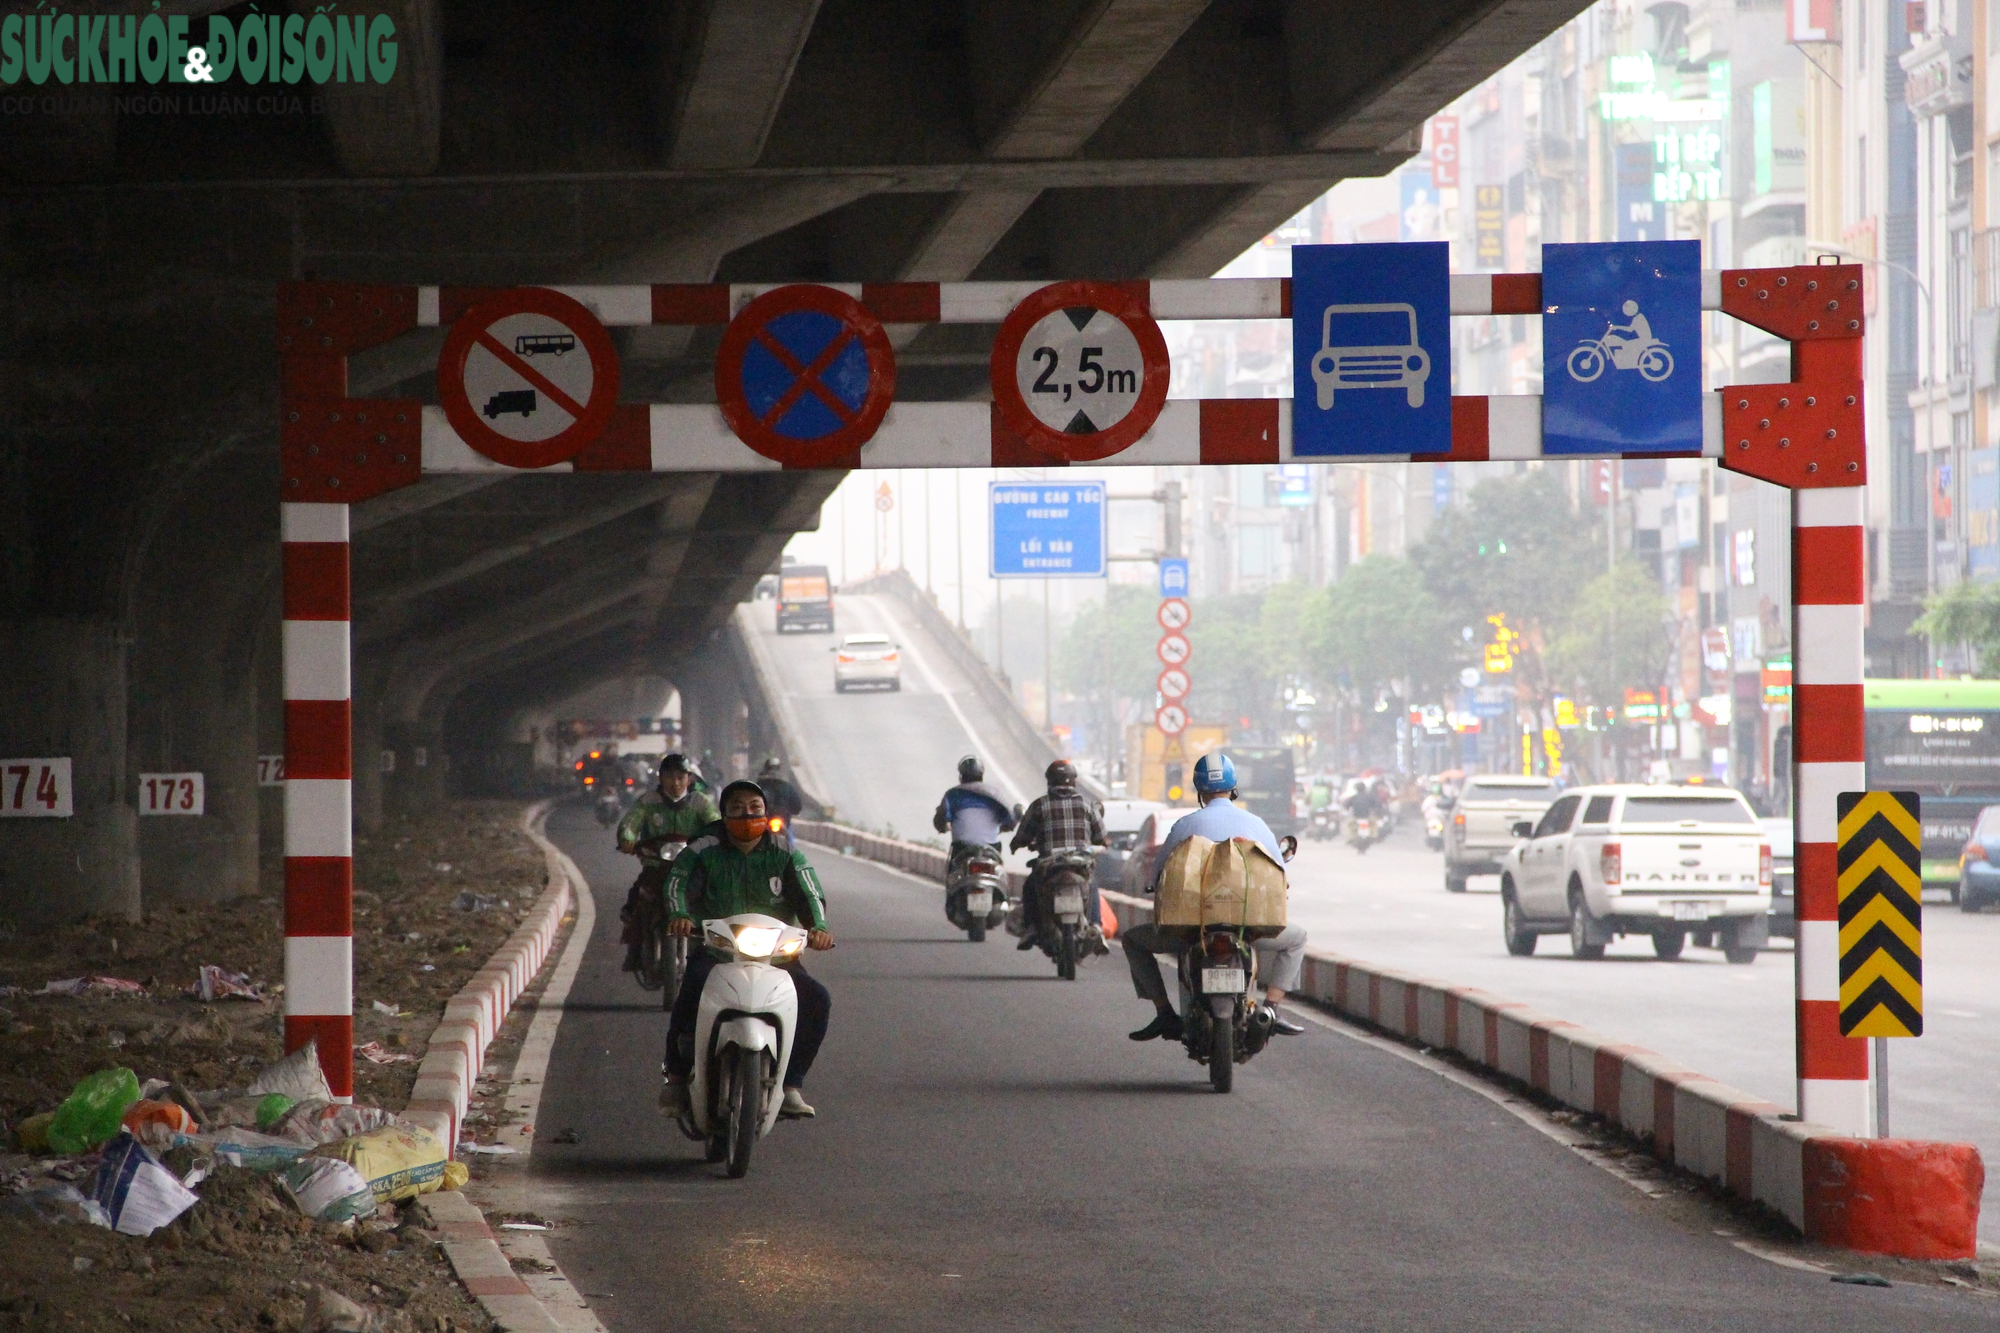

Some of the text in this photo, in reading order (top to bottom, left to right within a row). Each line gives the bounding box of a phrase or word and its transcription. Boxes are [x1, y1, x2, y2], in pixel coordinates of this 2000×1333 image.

[1435, 122, 1456, 183] TCL
[1032, 346, 1136, 403] 2,5m
[1044, 491, 1069, 504] CAO
[1026, 508, 1069, 519] FREEWAY
[146, 779, 194, 809] 173
[1625, 873, 1755, 882] RANGER
